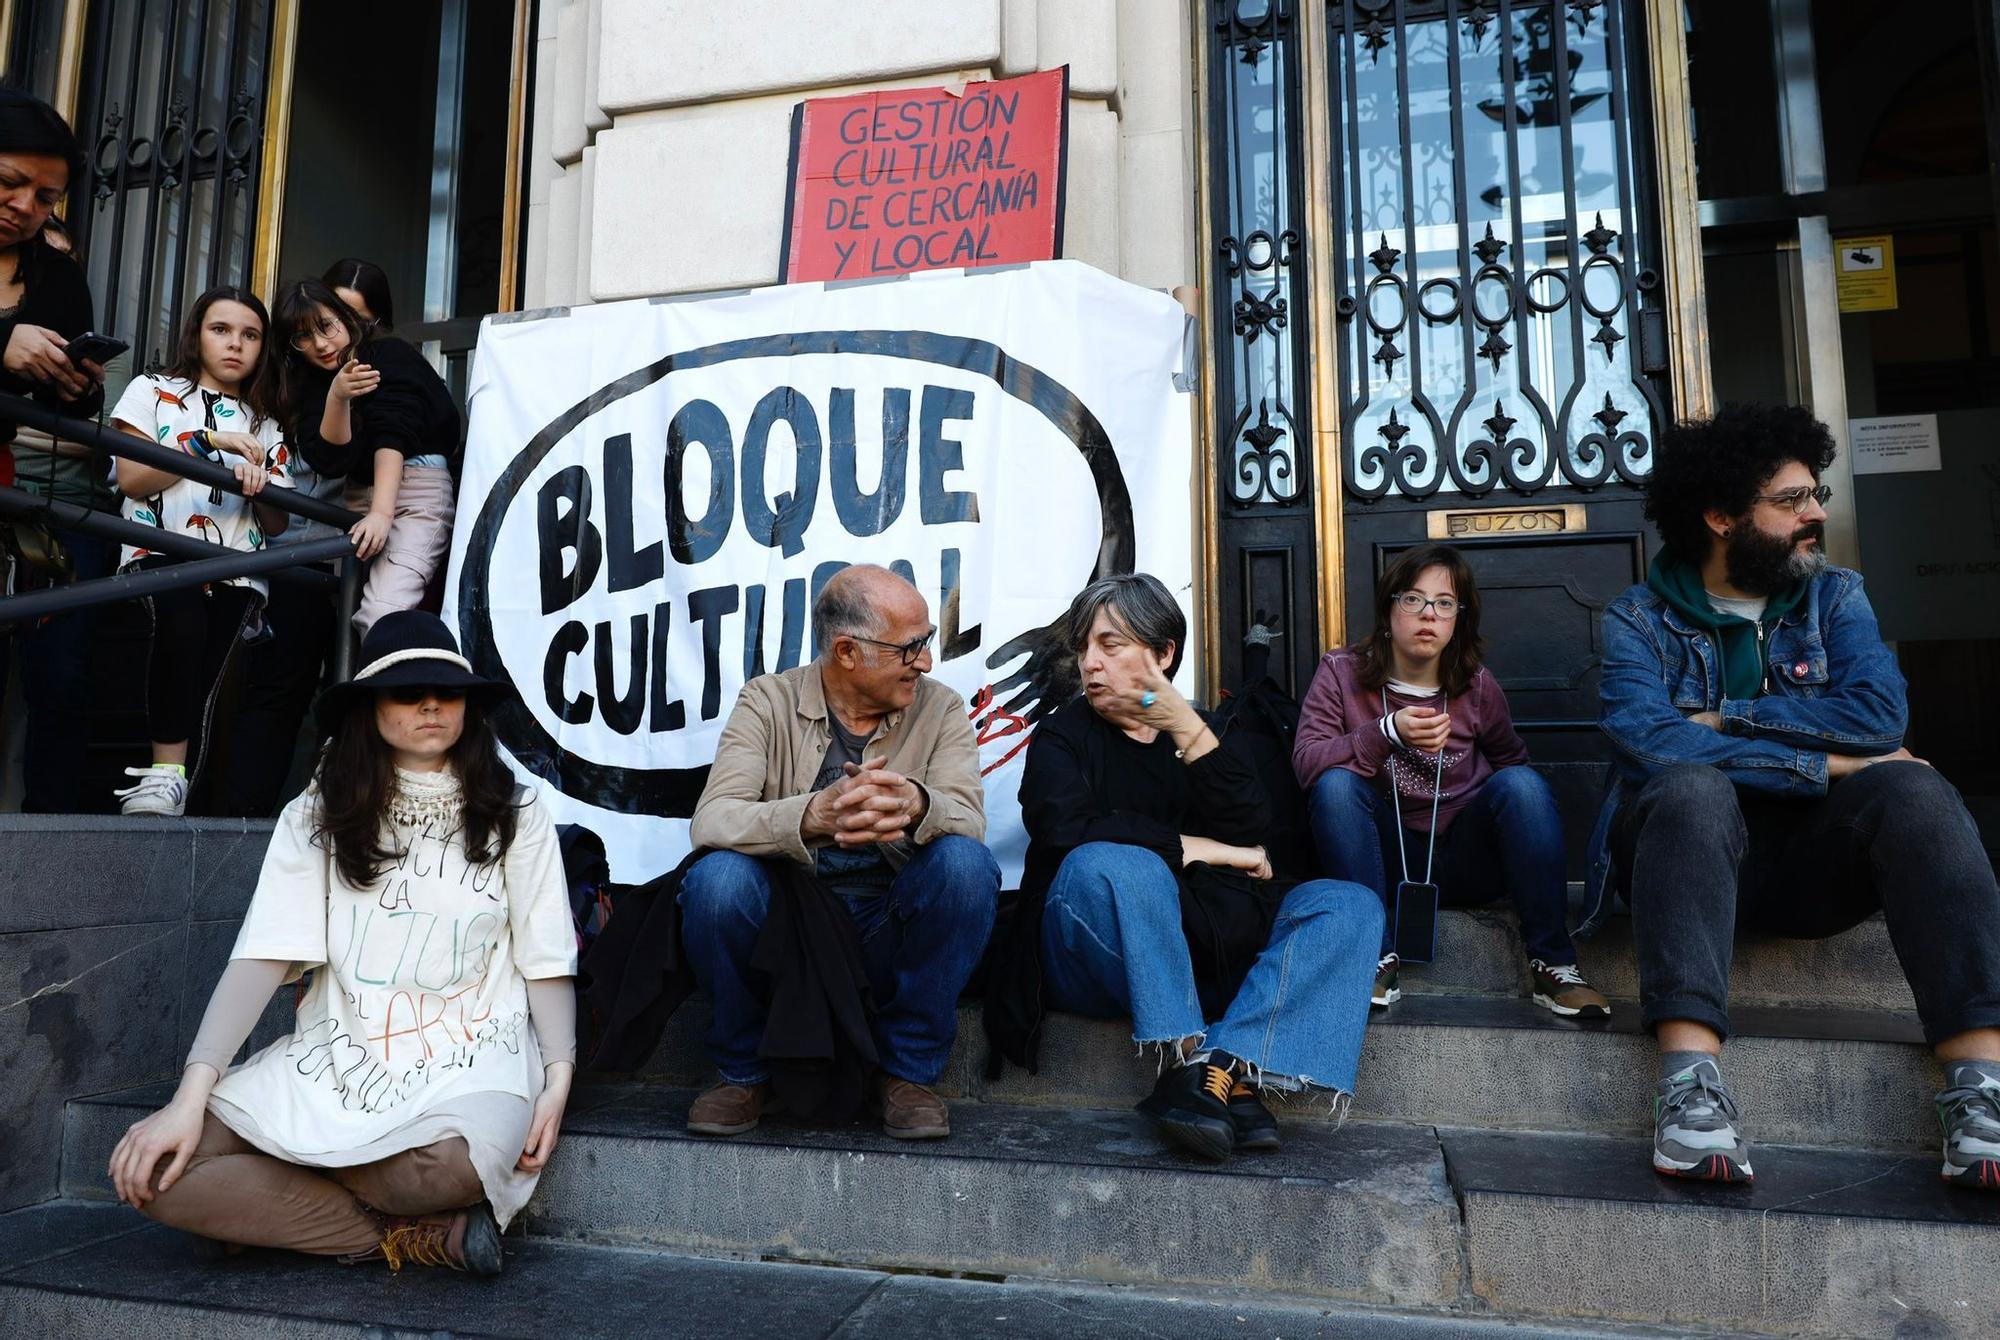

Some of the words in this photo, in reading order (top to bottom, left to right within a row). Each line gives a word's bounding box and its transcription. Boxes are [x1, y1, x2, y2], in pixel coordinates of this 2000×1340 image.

[839, 89, 1020, 145] GESTIÓN
[832, 130, 1016, 188] CULTURAL
[825, 194, 874, 231] DE
[882, 168, 1038, 228] CERCANÍA
[833, 240, 857, 280] Y
[870, 222, 998, 273] LOCAL
[537, 384, 980, 616] BLOQUE
[1448, 512, 1563, 533] BUZÓN
[544, 548, 981, 735] CULTUL
[329, 904, 505, 992] ULTUR
[367, 984, 491, 1062] ART
